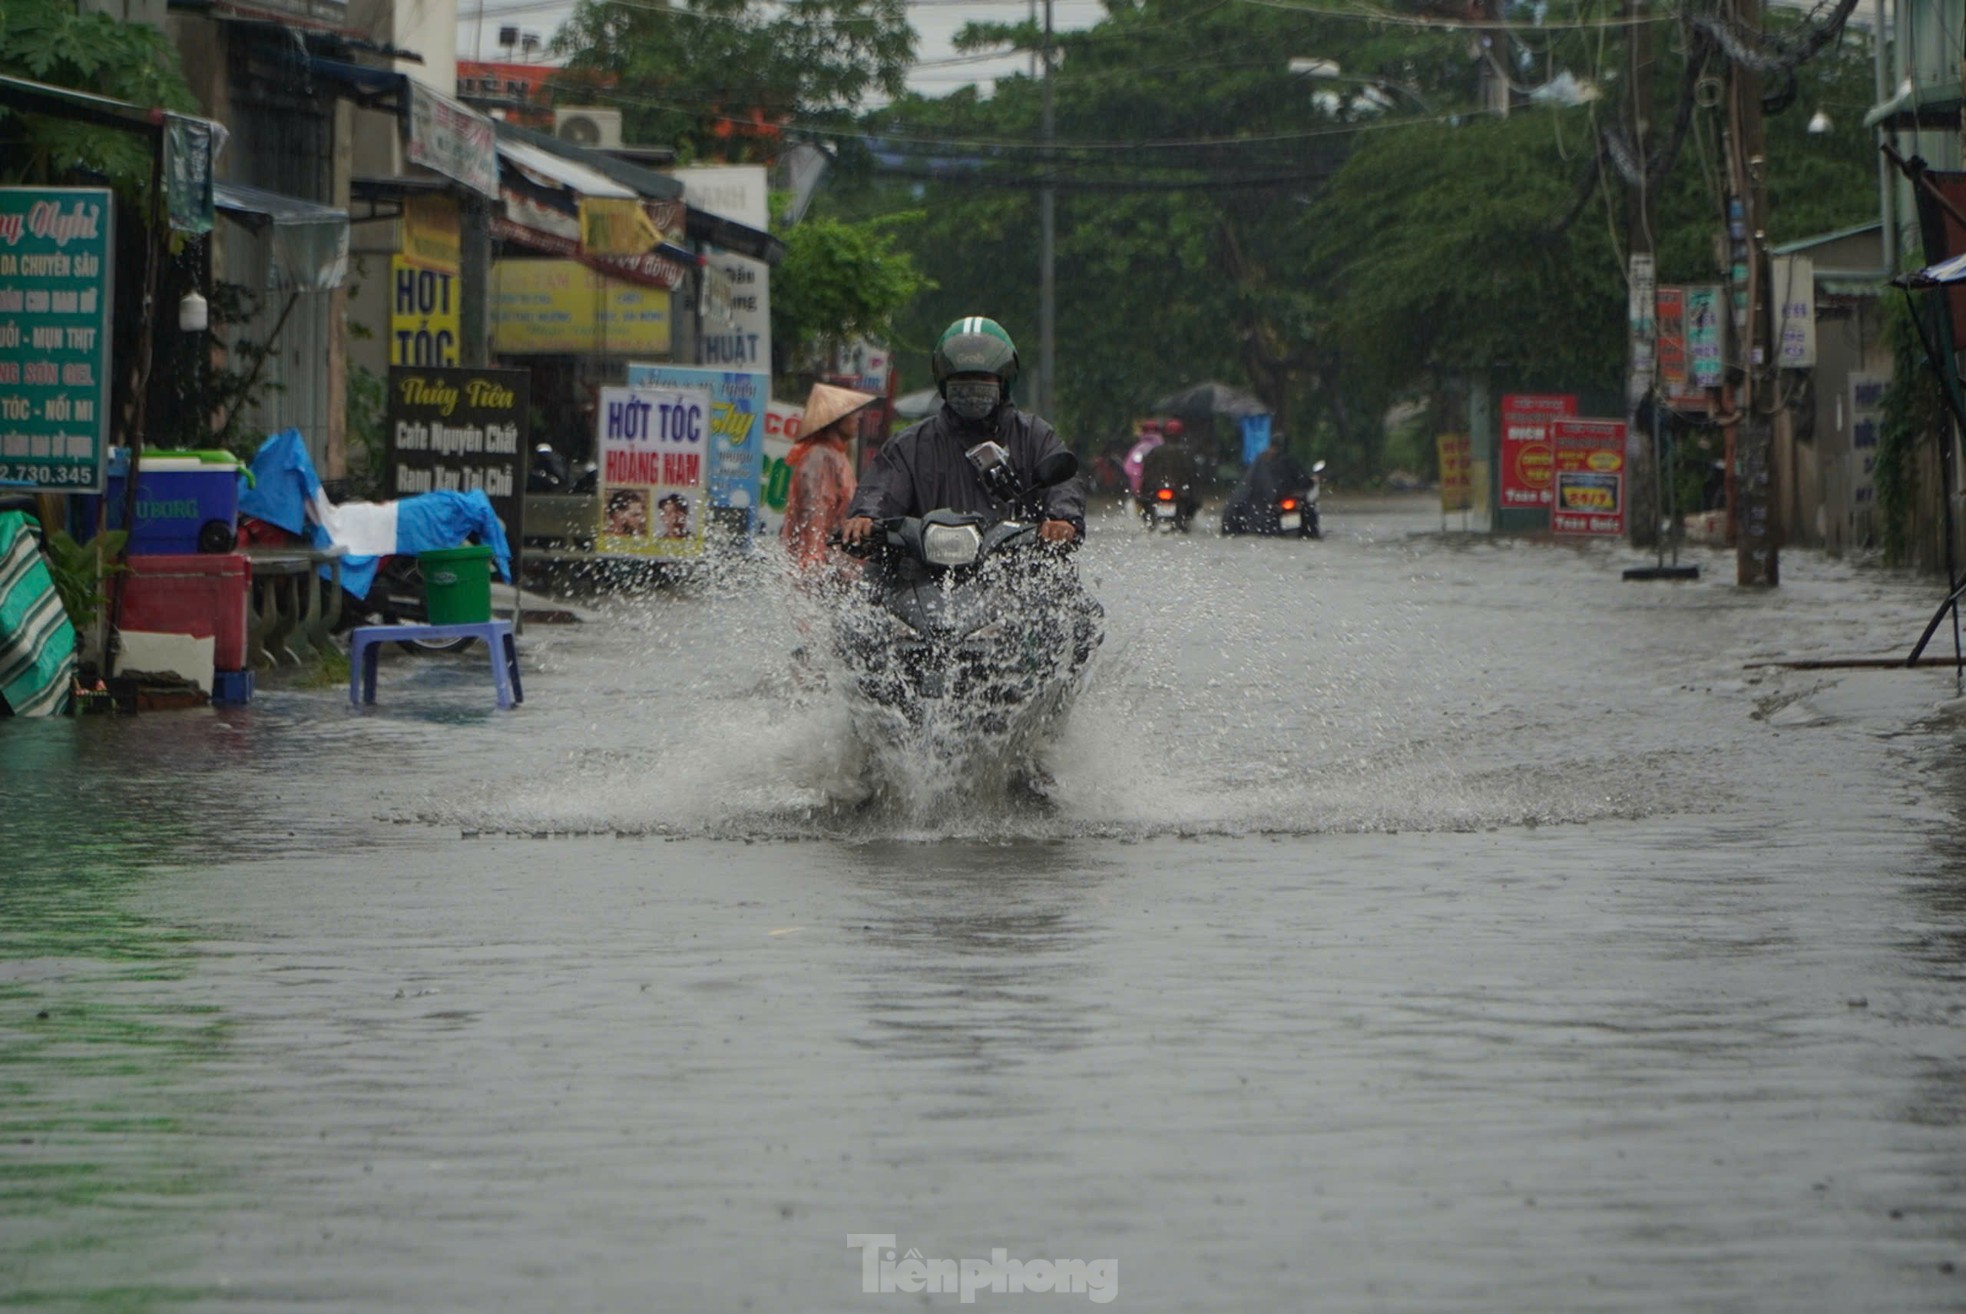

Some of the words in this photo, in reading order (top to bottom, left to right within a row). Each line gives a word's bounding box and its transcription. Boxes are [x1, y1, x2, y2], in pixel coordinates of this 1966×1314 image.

[396, 421, 428, 450] Cafe
[607, 393, 652, 441] HỚT
[659, 395, 702, 443] TÓC
[663, 452, 701, 488] NAM
